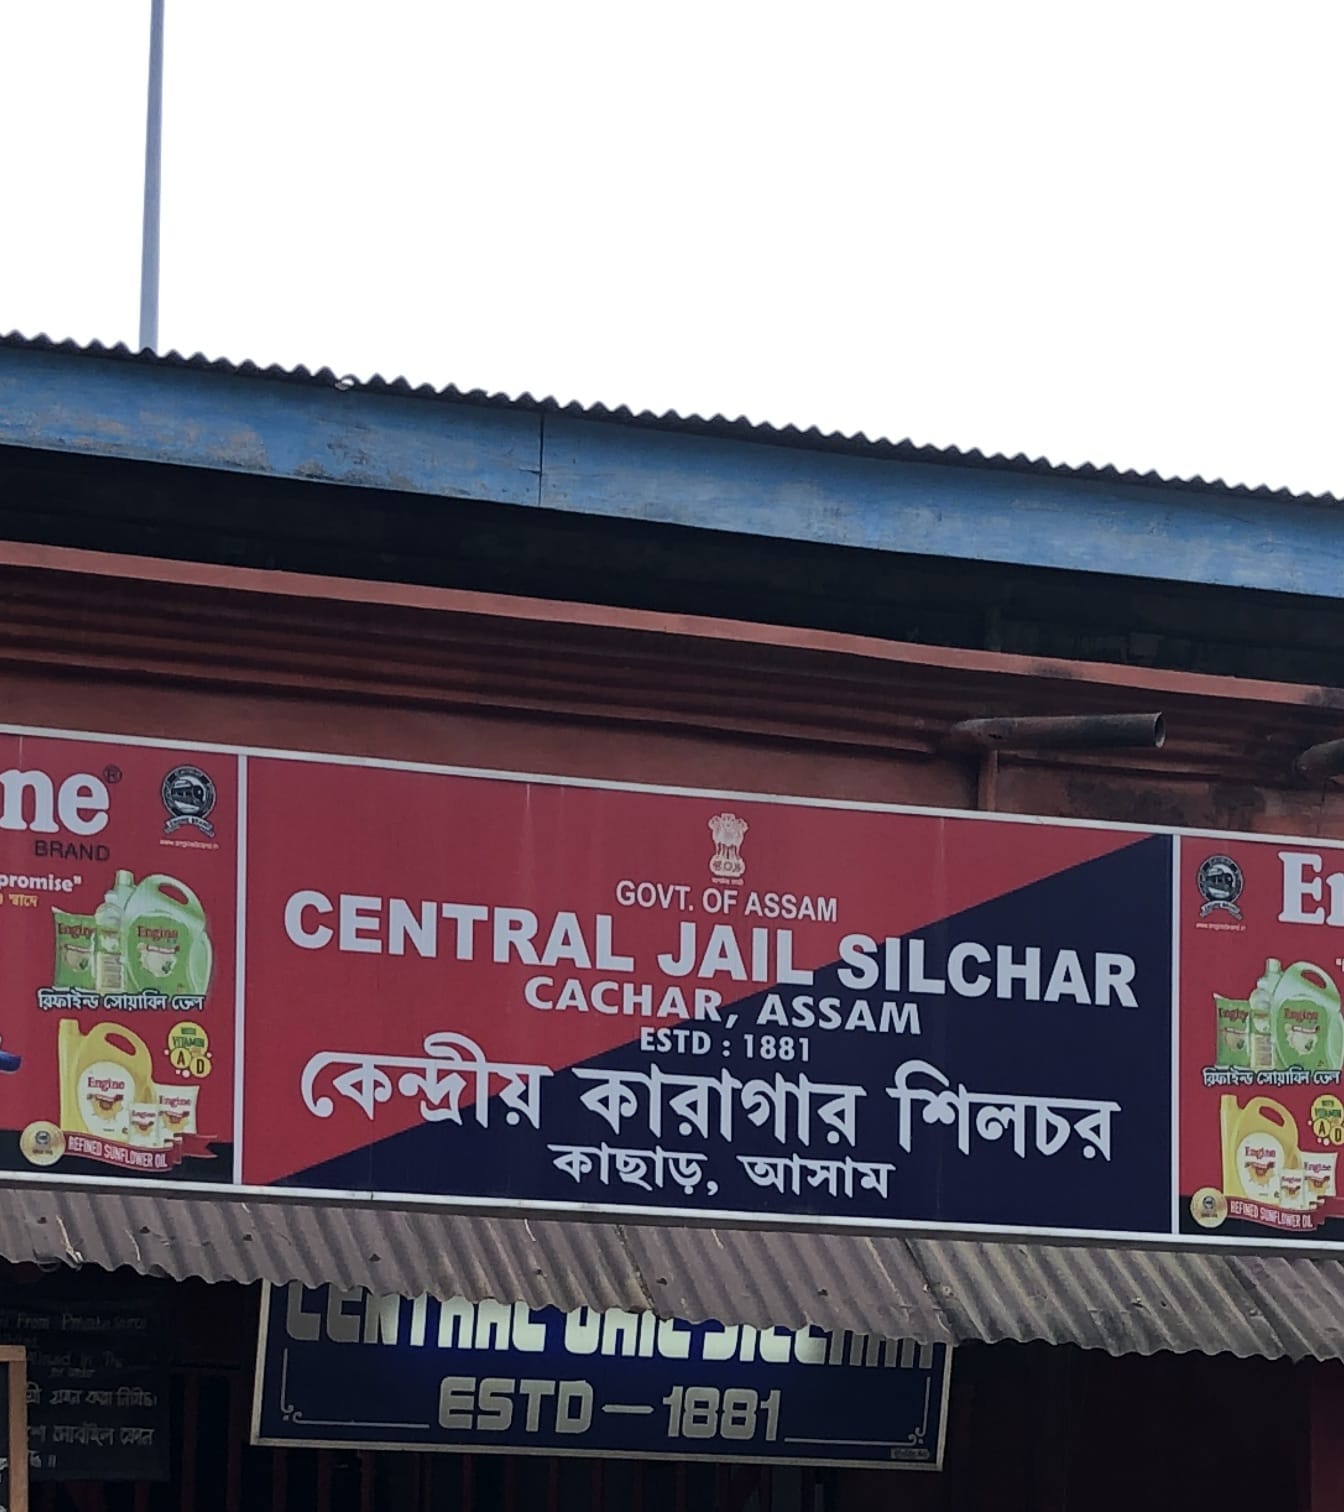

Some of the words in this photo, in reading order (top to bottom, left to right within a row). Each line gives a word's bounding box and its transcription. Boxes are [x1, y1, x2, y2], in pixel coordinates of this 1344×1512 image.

[34, 839, 110, 862] BRAND
[616, 880, 695, 912] GOVT.
[702, 887, 738, 914] OF
[744, 891, 838, 922] ASSAM
[284, 889, 635, 974] CENTRAL
[657, 921, 814, 986] JAIL
[837, 933, 1140, 1008] SILCHAR
[523, 976, 738, 1030] CACHAR,
[756, 993, 921, 1035] ASSAM
[640, 1026, 712, 1055] ESTD
[743, 1034, 810, 1062] 1881
[300, 1030, 554, 1130] কেন্দ্রীয়
[572, 1063, 867, 1147] কারাগার
[885, 1058, 1121, 1162] শিলচর
[547, 1142, 719, 1196] কাছাড়,
[737, 1153, 897, 1199] আসাম
[438, 1376, 594, 1434] ESTD
[663, 1385, 782, 1441] 1881
